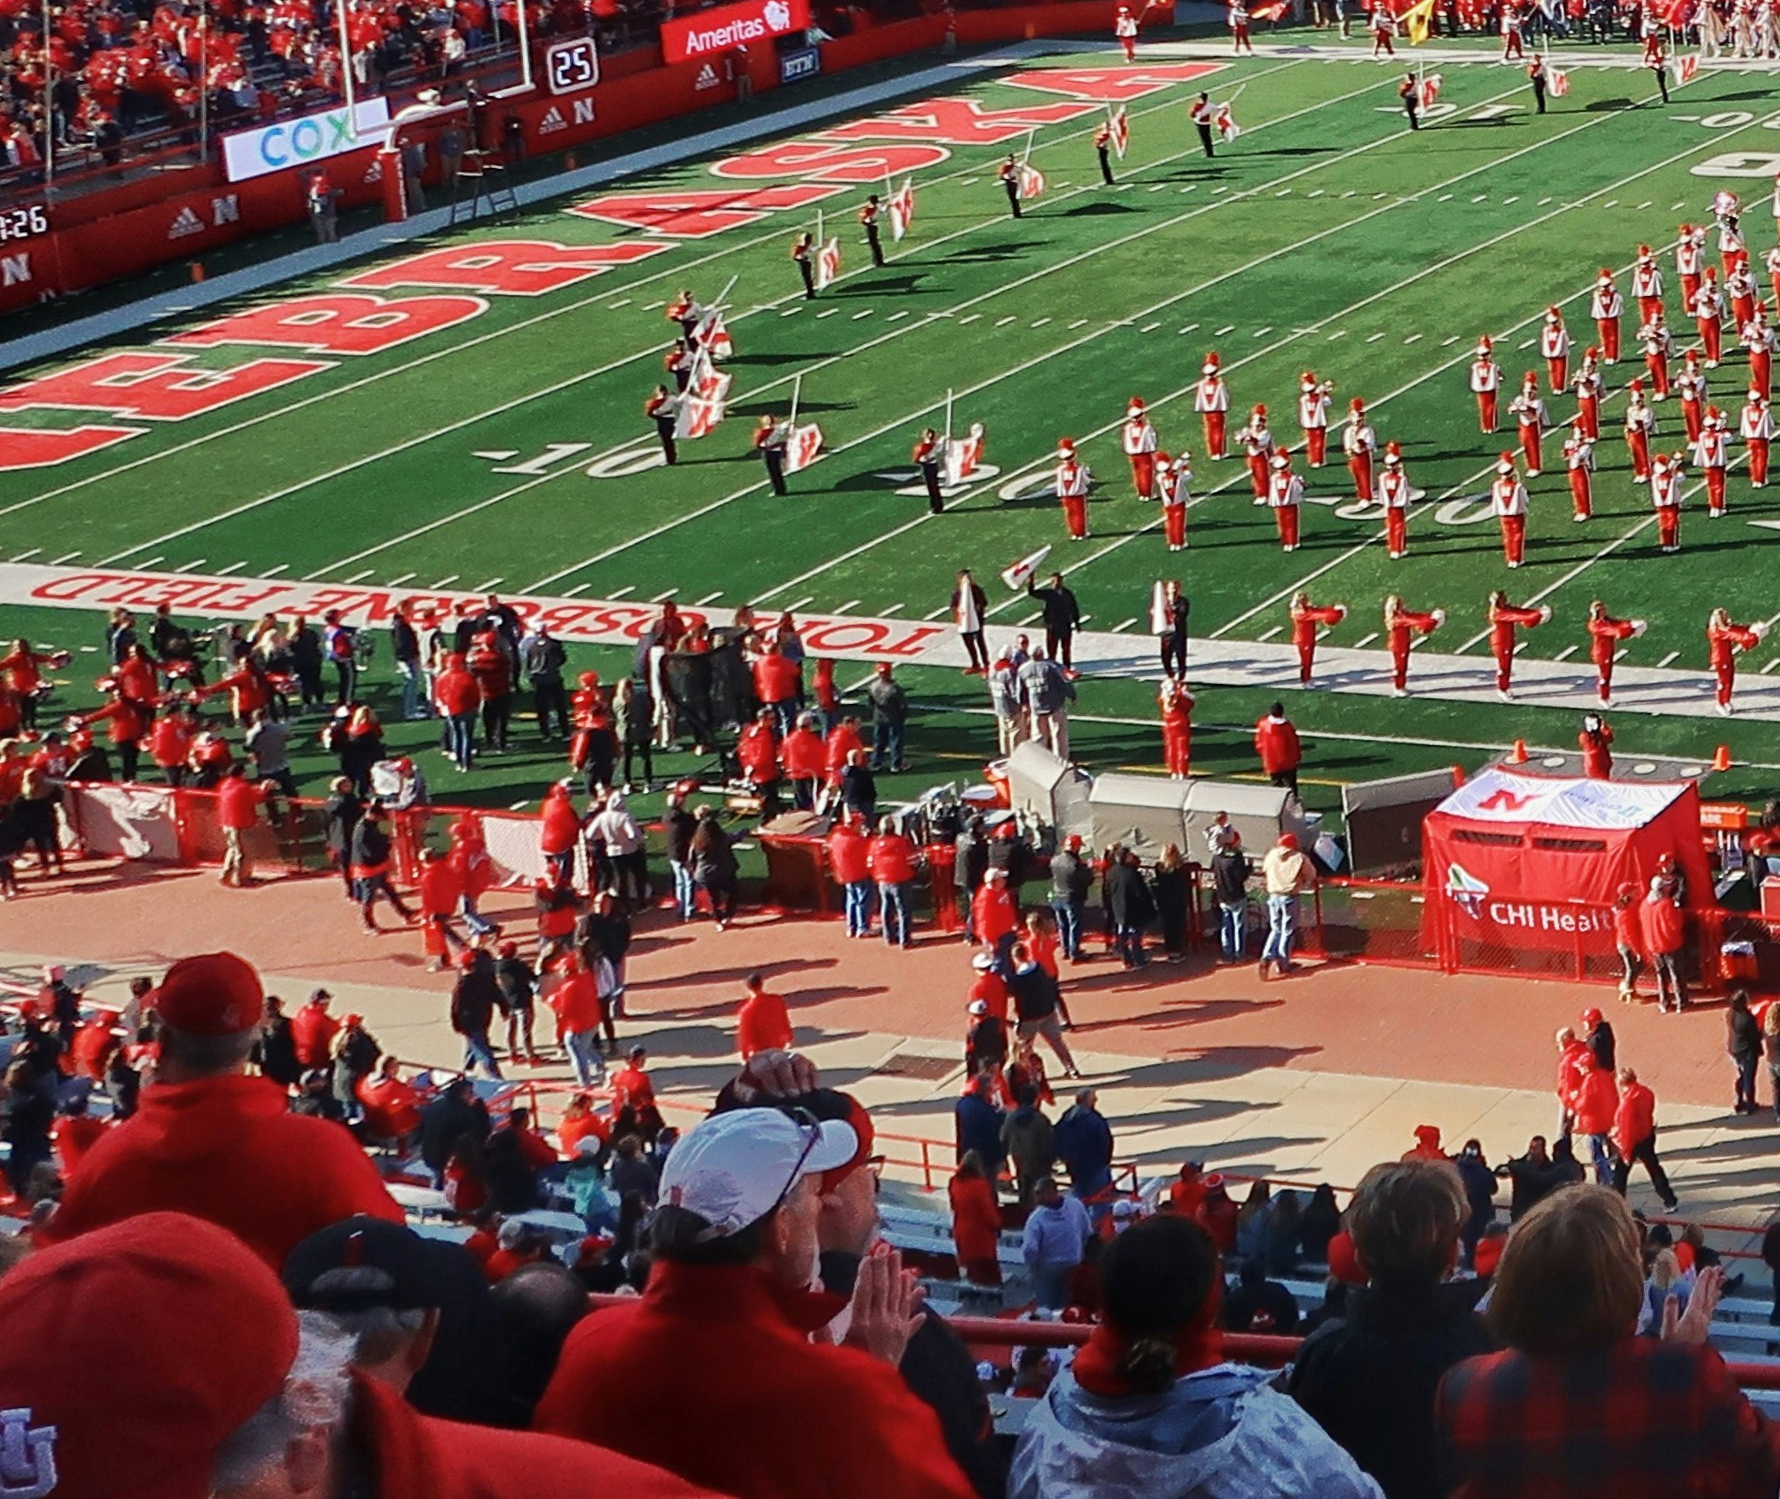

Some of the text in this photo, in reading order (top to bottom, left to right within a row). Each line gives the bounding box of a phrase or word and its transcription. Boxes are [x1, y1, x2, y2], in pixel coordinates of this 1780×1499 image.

[685, 16, 765, 57] Ameritas
[555, 46, 591, 86] 25
[573, 97, 596, 124] N
[260, 112, 357, 167] COX
[211, 193, 239, 226] N
[1, 252, 33, 287] N
[30, 573, 295, 617] FIELD
[1491, 902, 1616, 932] CHI Healt
